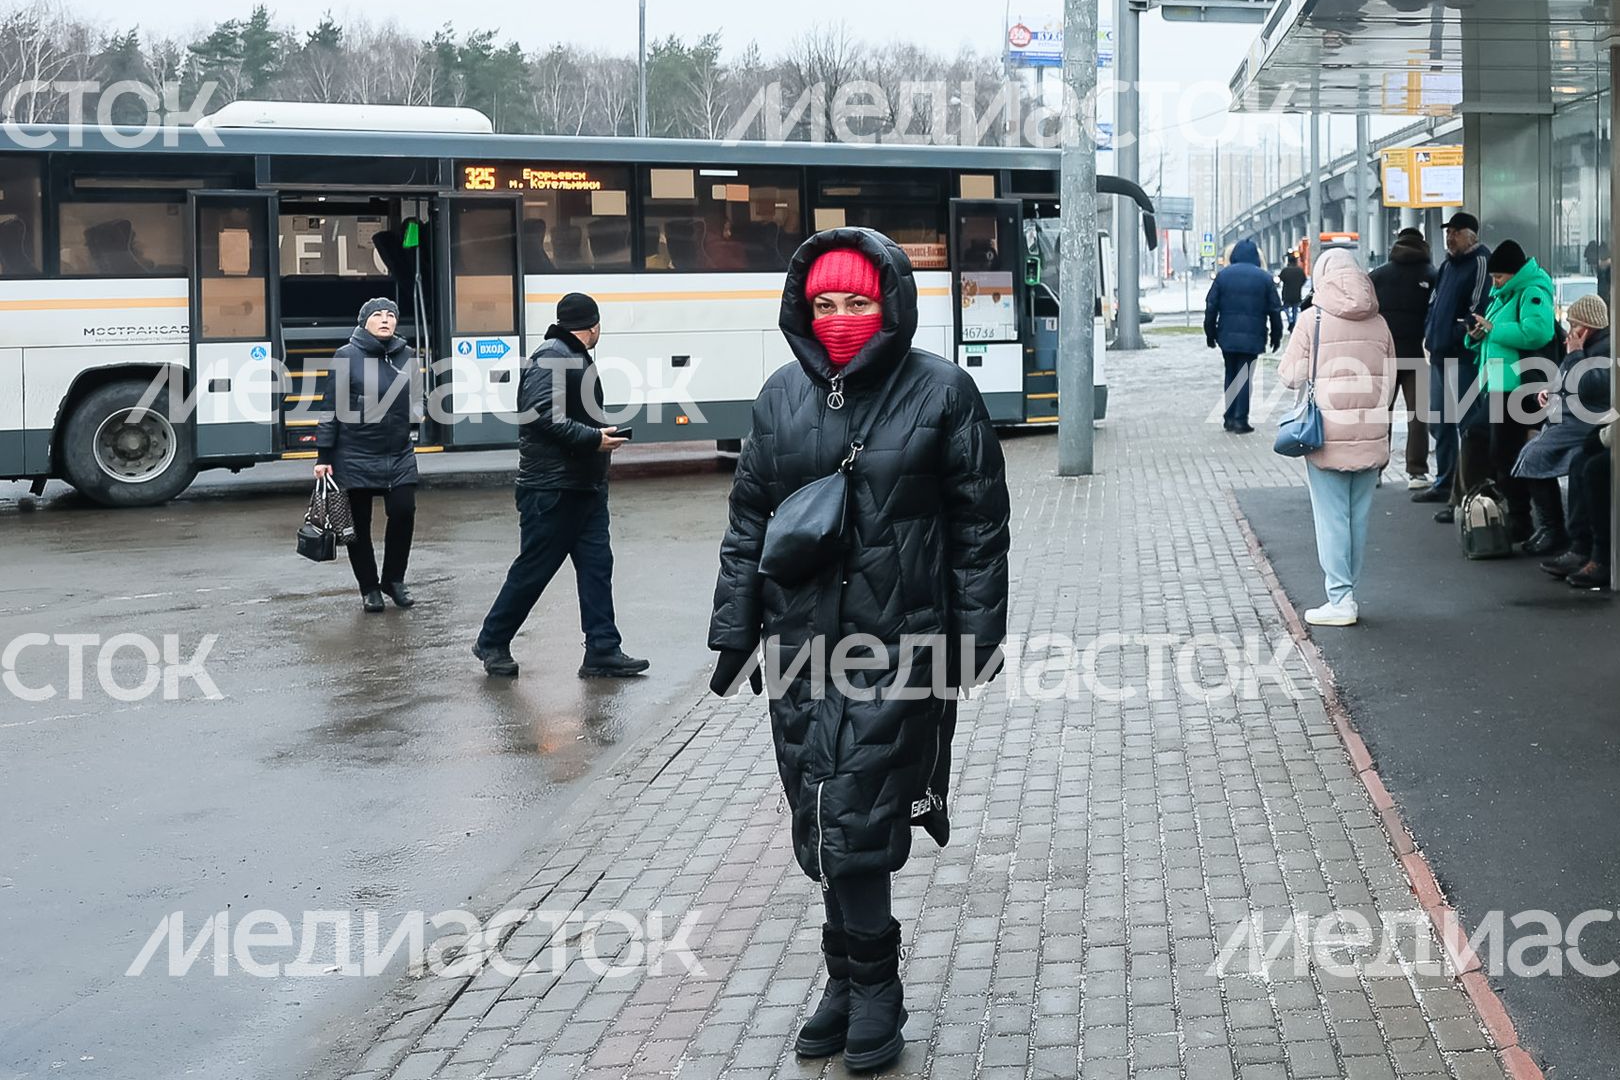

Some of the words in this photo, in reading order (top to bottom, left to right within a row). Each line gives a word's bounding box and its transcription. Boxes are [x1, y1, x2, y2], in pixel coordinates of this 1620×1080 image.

[465, 167, 496, 190] 325
[530, 179, 601, 190] Котельники
[480, 343, 505, 356] ВХОД
